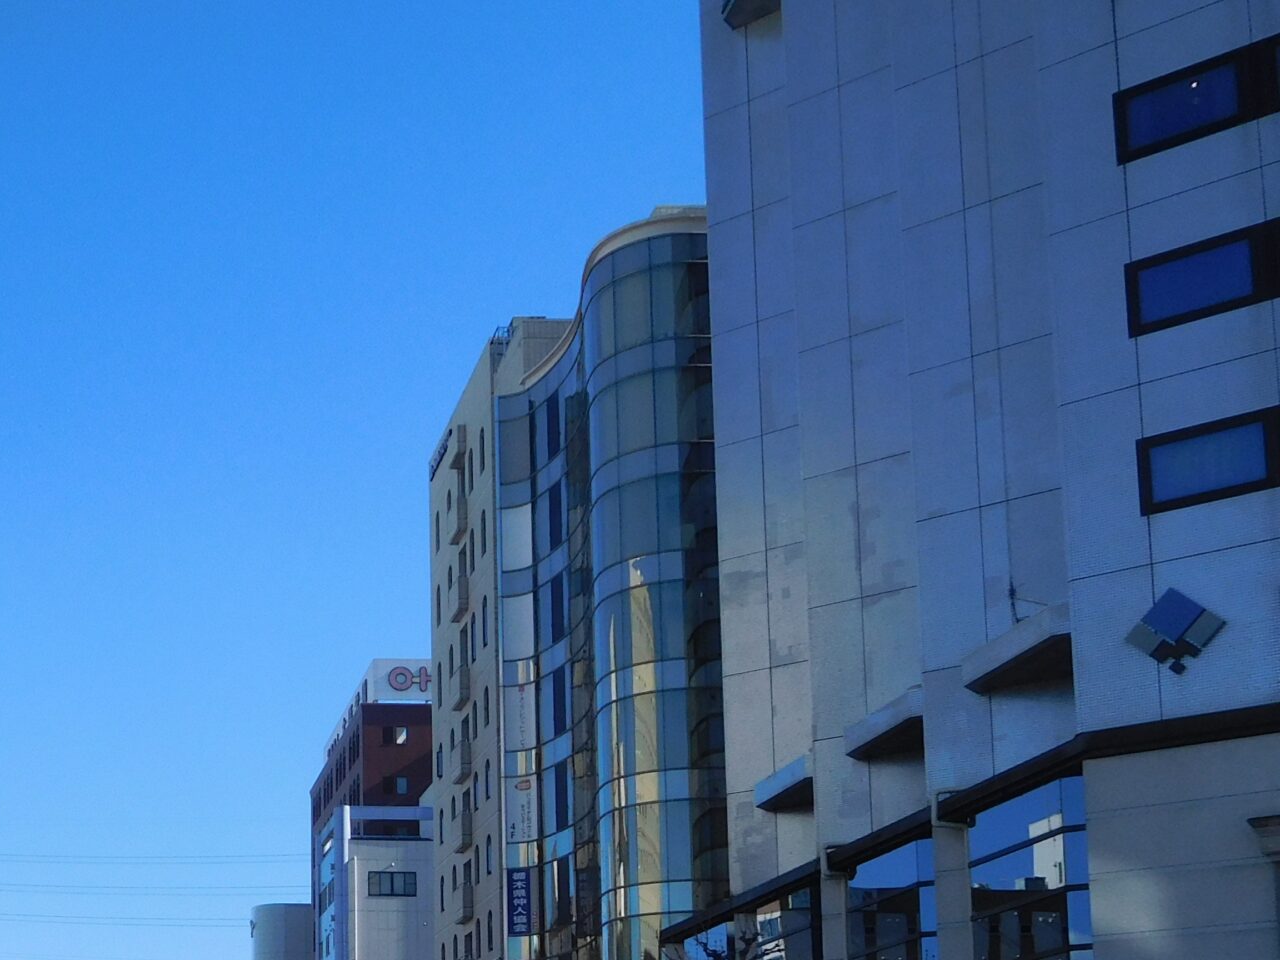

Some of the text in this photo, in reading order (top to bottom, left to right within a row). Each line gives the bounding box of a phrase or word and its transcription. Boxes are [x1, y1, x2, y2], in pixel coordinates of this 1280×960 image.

[512, 872, 528, 932] 栃木県仲人協会
